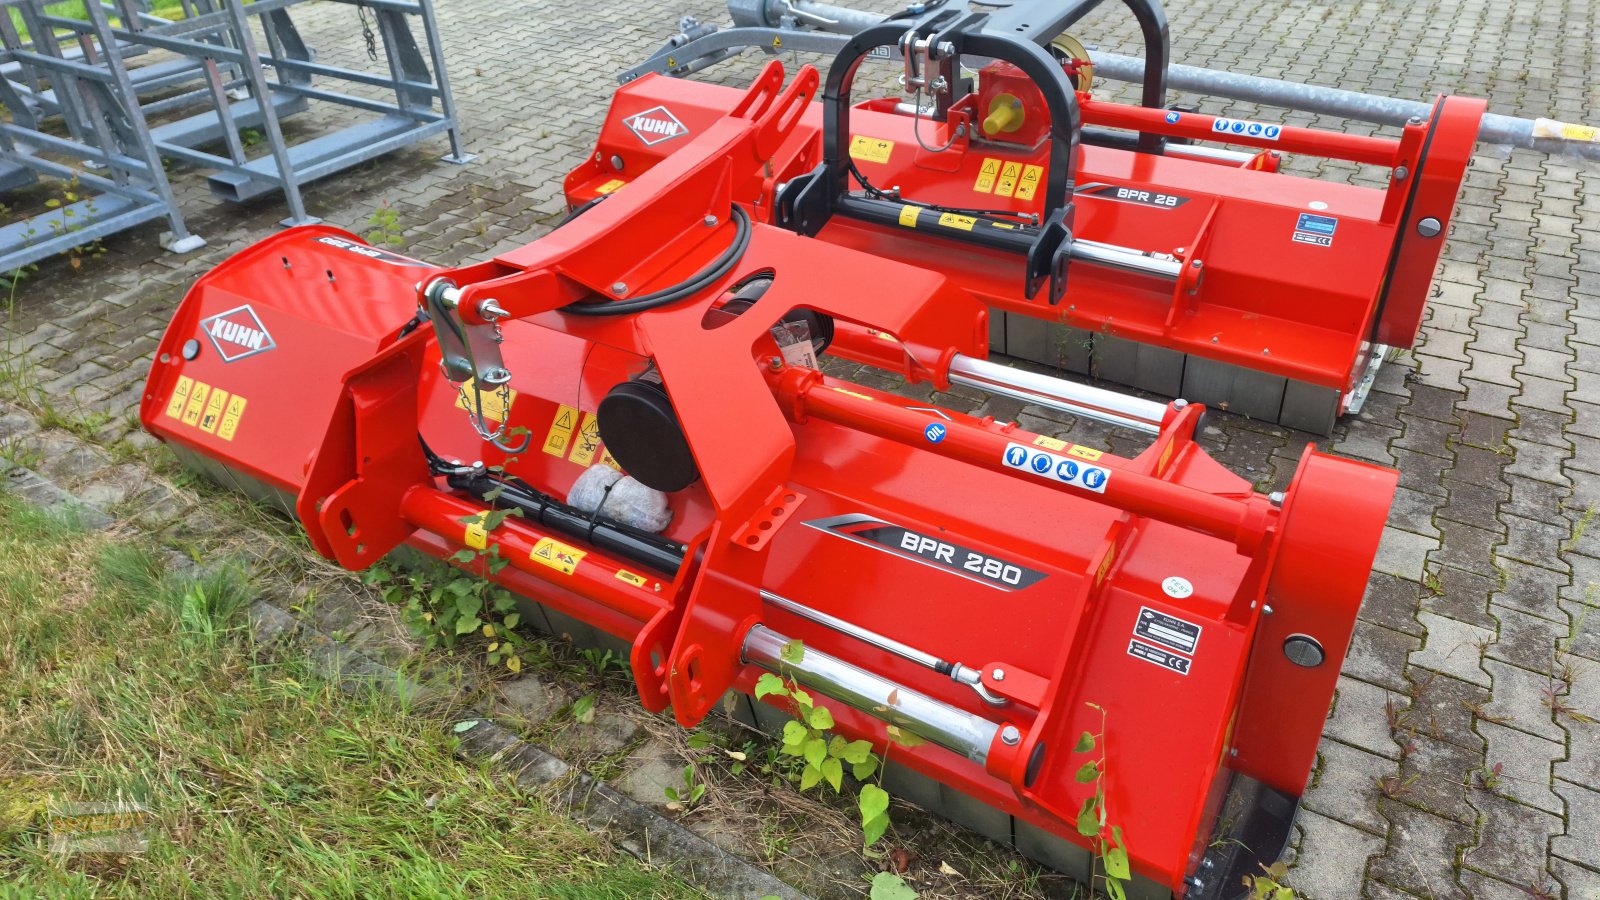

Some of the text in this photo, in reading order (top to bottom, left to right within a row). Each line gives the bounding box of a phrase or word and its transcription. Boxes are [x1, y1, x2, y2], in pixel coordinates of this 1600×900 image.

[632, 116, 679, 136] KUHN
[1166, 112, 1178, 122] OIL
[1117, 187, 1178, 207] BPR 28
[211, 317, 265, 350] KUHN
[926, 425, 945, 442] OIL
[900, 531, 1022, 585] BPR 280
[1167, 585, 1178, 595] OK
[1170, 578, 1190, 594] TEST
